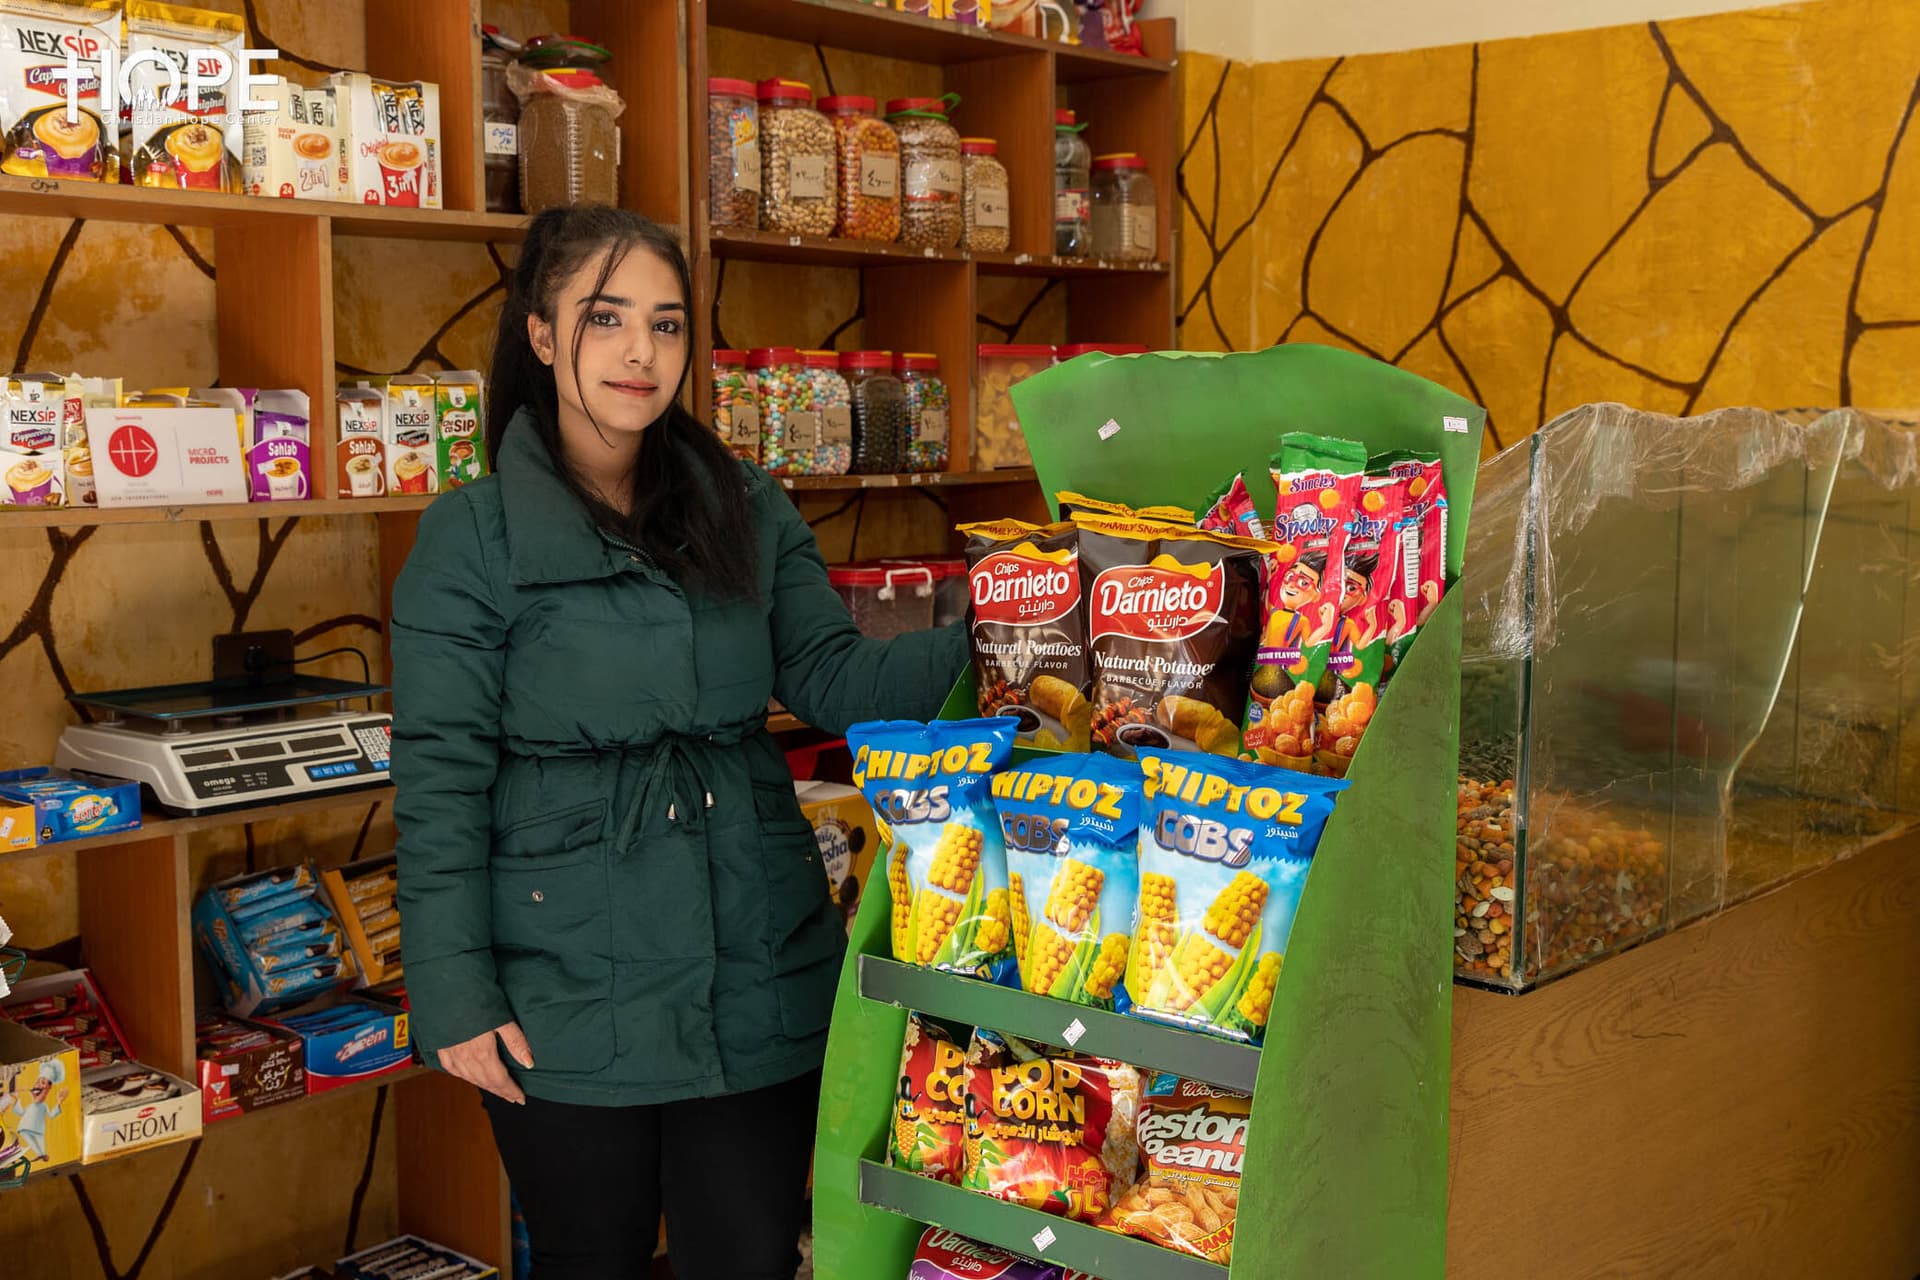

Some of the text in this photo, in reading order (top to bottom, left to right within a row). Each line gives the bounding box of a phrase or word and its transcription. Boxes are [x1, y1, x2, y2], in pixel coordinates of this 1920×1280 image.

[10, 406, 56, 422] NEXSIP
[395, 410, 430, 425] NEXSIP
[345, 418, 377, 431] NEXSIP
[454, 419, 475, 432] SIP
[267, 442, 298, 456] Sahlab
[350, 441, 376, 455] Sahlab
[189, 456, 229, 464] PROJECTS
[994, 562, 1020, 576] Chips
[972, 568, 1070, 606] Darnieto
[1127, 575, 1154, 588] Chips
[1100, 579, 1208, 617] Darnieto
[975, 637, 1082, 657] Natural Potatoes
[1094, 651, 1150, 671] Natural
[1275, 651, 1301, 659] FLAVOR
[1328, 655, 1354, 664] LAVOR
[985, 659, 1068, 670] BARBECUE FLAVOR
[1106, 675, 1204, 689] BARBECUE FLAVOR
[852, 742, 993, 790] CHIPTOZ
[991, 770, 1125, 820] HIPTOZ
[874, 785, 951, 825] COBS
[1154, 809, 1254, 869] COBS
[991, 1058, 1082, 1093] POP
[992, 1088, 1085, 1124] CORN
[112, 1112, 178, 1146] NEOM
